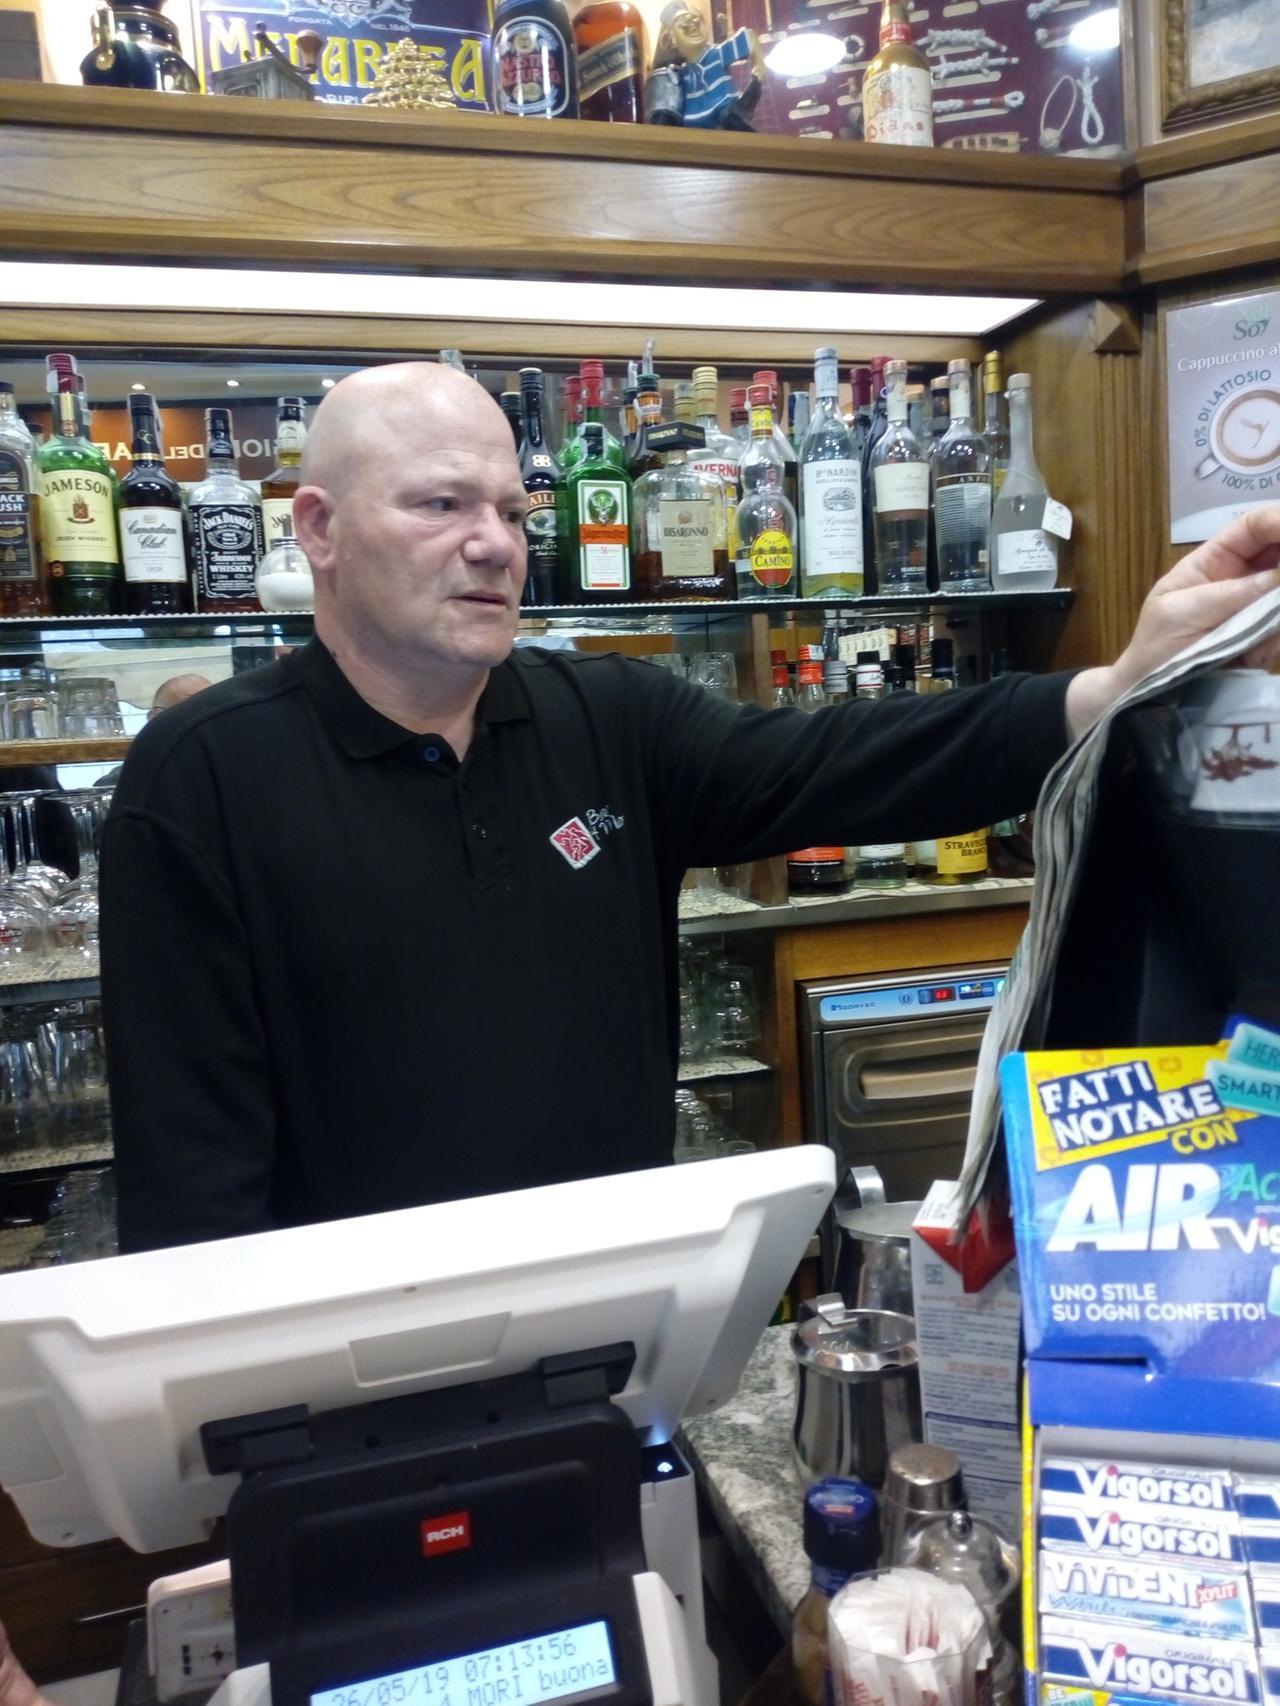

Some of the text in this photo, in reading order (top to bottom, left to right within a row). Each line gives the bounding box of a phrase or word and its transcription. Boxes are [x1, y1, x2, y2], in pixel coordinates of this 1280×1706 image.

[1177, 348, 1264, 371] Cappuccino
[1194, 369, 1272, 447] 0% DI LATTOSIO
[44, 477, 109, 498] JAMESON
[1222, 473, 1273, 490] 100% DI
[209, 565, 255, 573] WHISKEY
[1038, 1061, 1153, 1115] FATTI
[1053, 1083, 1221, 1150] NOTARE
[1172, 1120, 1237, 1154] CON
[1045, 1163, 1221, 1251] AIR
[1051, 1283, 1157, 1302] UNO STILE
[1053, 1303, 1266, 1321] SU OGNI CONFETTO!
[1072, 1464, 1225, 1511] Vigorsol
[427, 1525, 464, 1543] RCH
[1073, 1511, 1233, 1559] Vigorsol
[464, 1634, 577, 1682] 07:13:56
[468, 1676, 522, 1706] MORI
[539, 1657, 609, 1692] buona
[1077, 1637, 1248, 1700] Vigorsol
